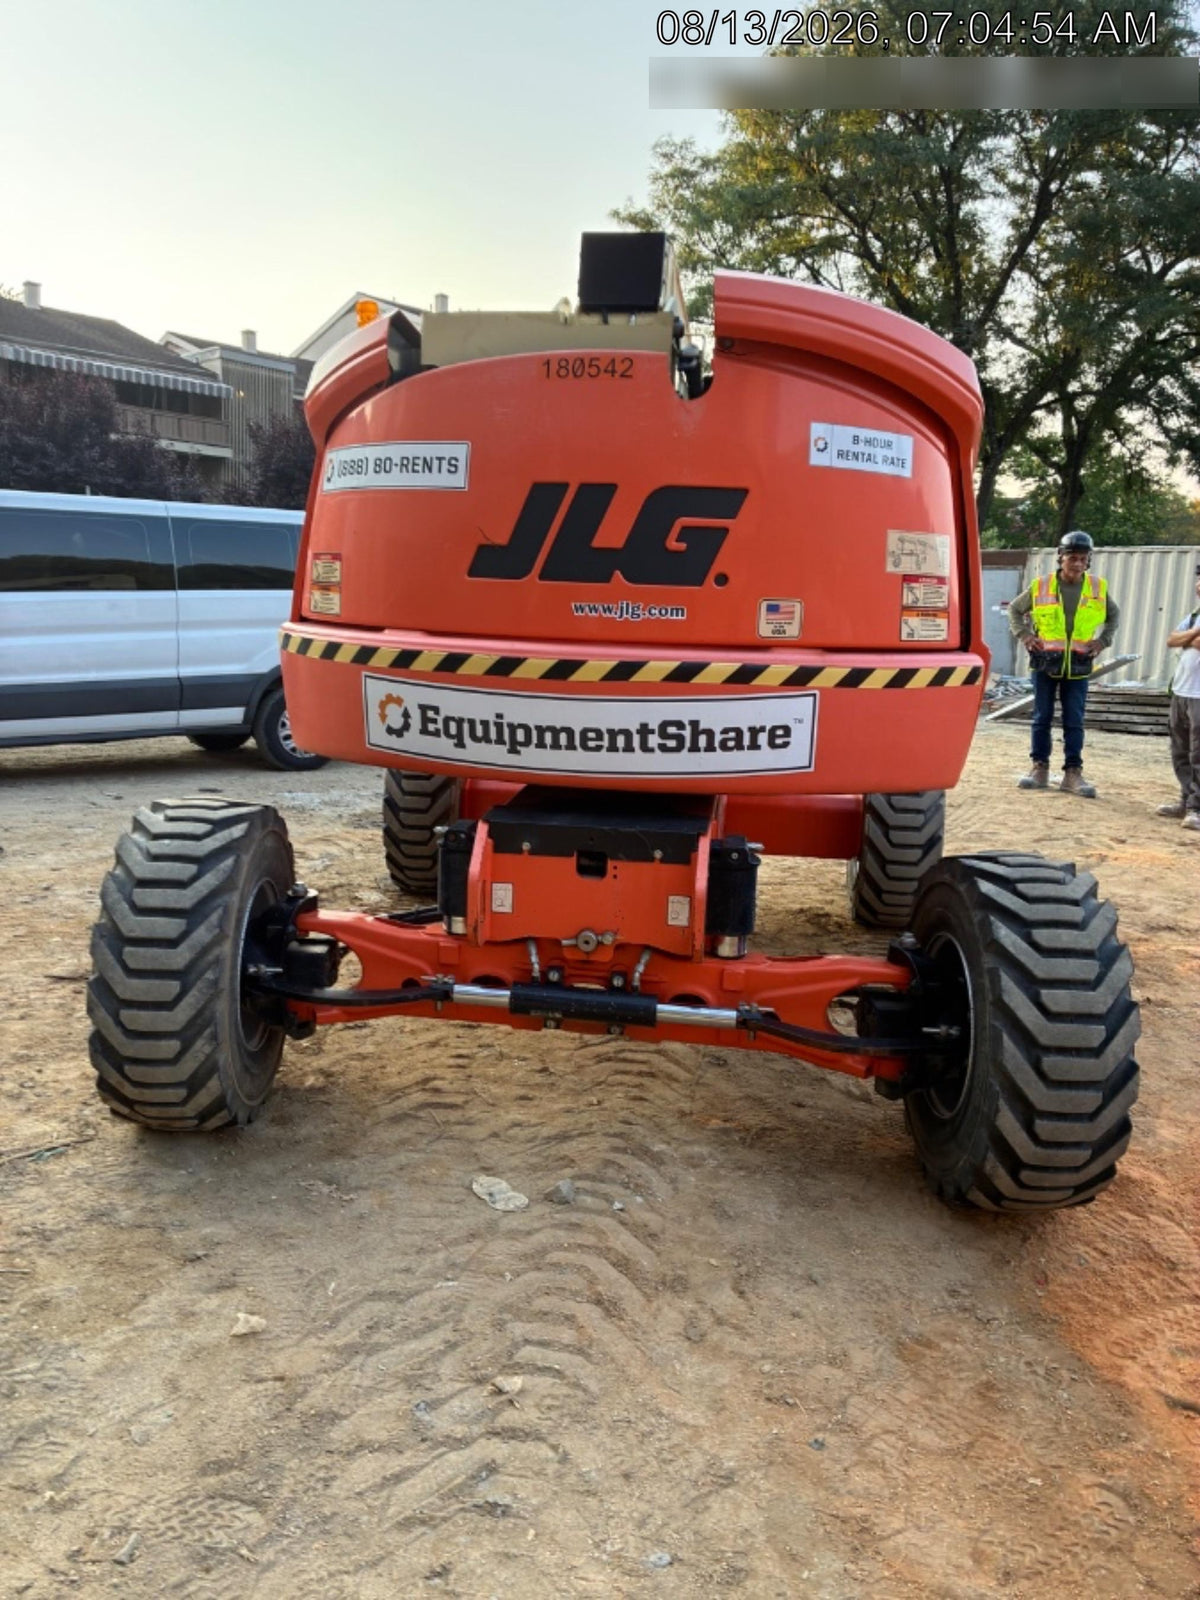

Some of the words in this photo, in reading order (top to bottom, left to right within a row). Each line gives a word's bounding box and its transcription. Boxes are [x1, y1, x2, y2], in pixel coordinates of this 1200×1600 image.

[543, 357, 635, 379] 180542
[852, 435, 893, 450] 8-HOUR
[373, 456, 459, 474] 80-RENTS
[837, 449, 879, 464] RENTAL
[881, 455, 907, 469] RATE
[572, 600, 687, 621] www.jlg.com
[417, 703, 793, 755] EquipmentShare
